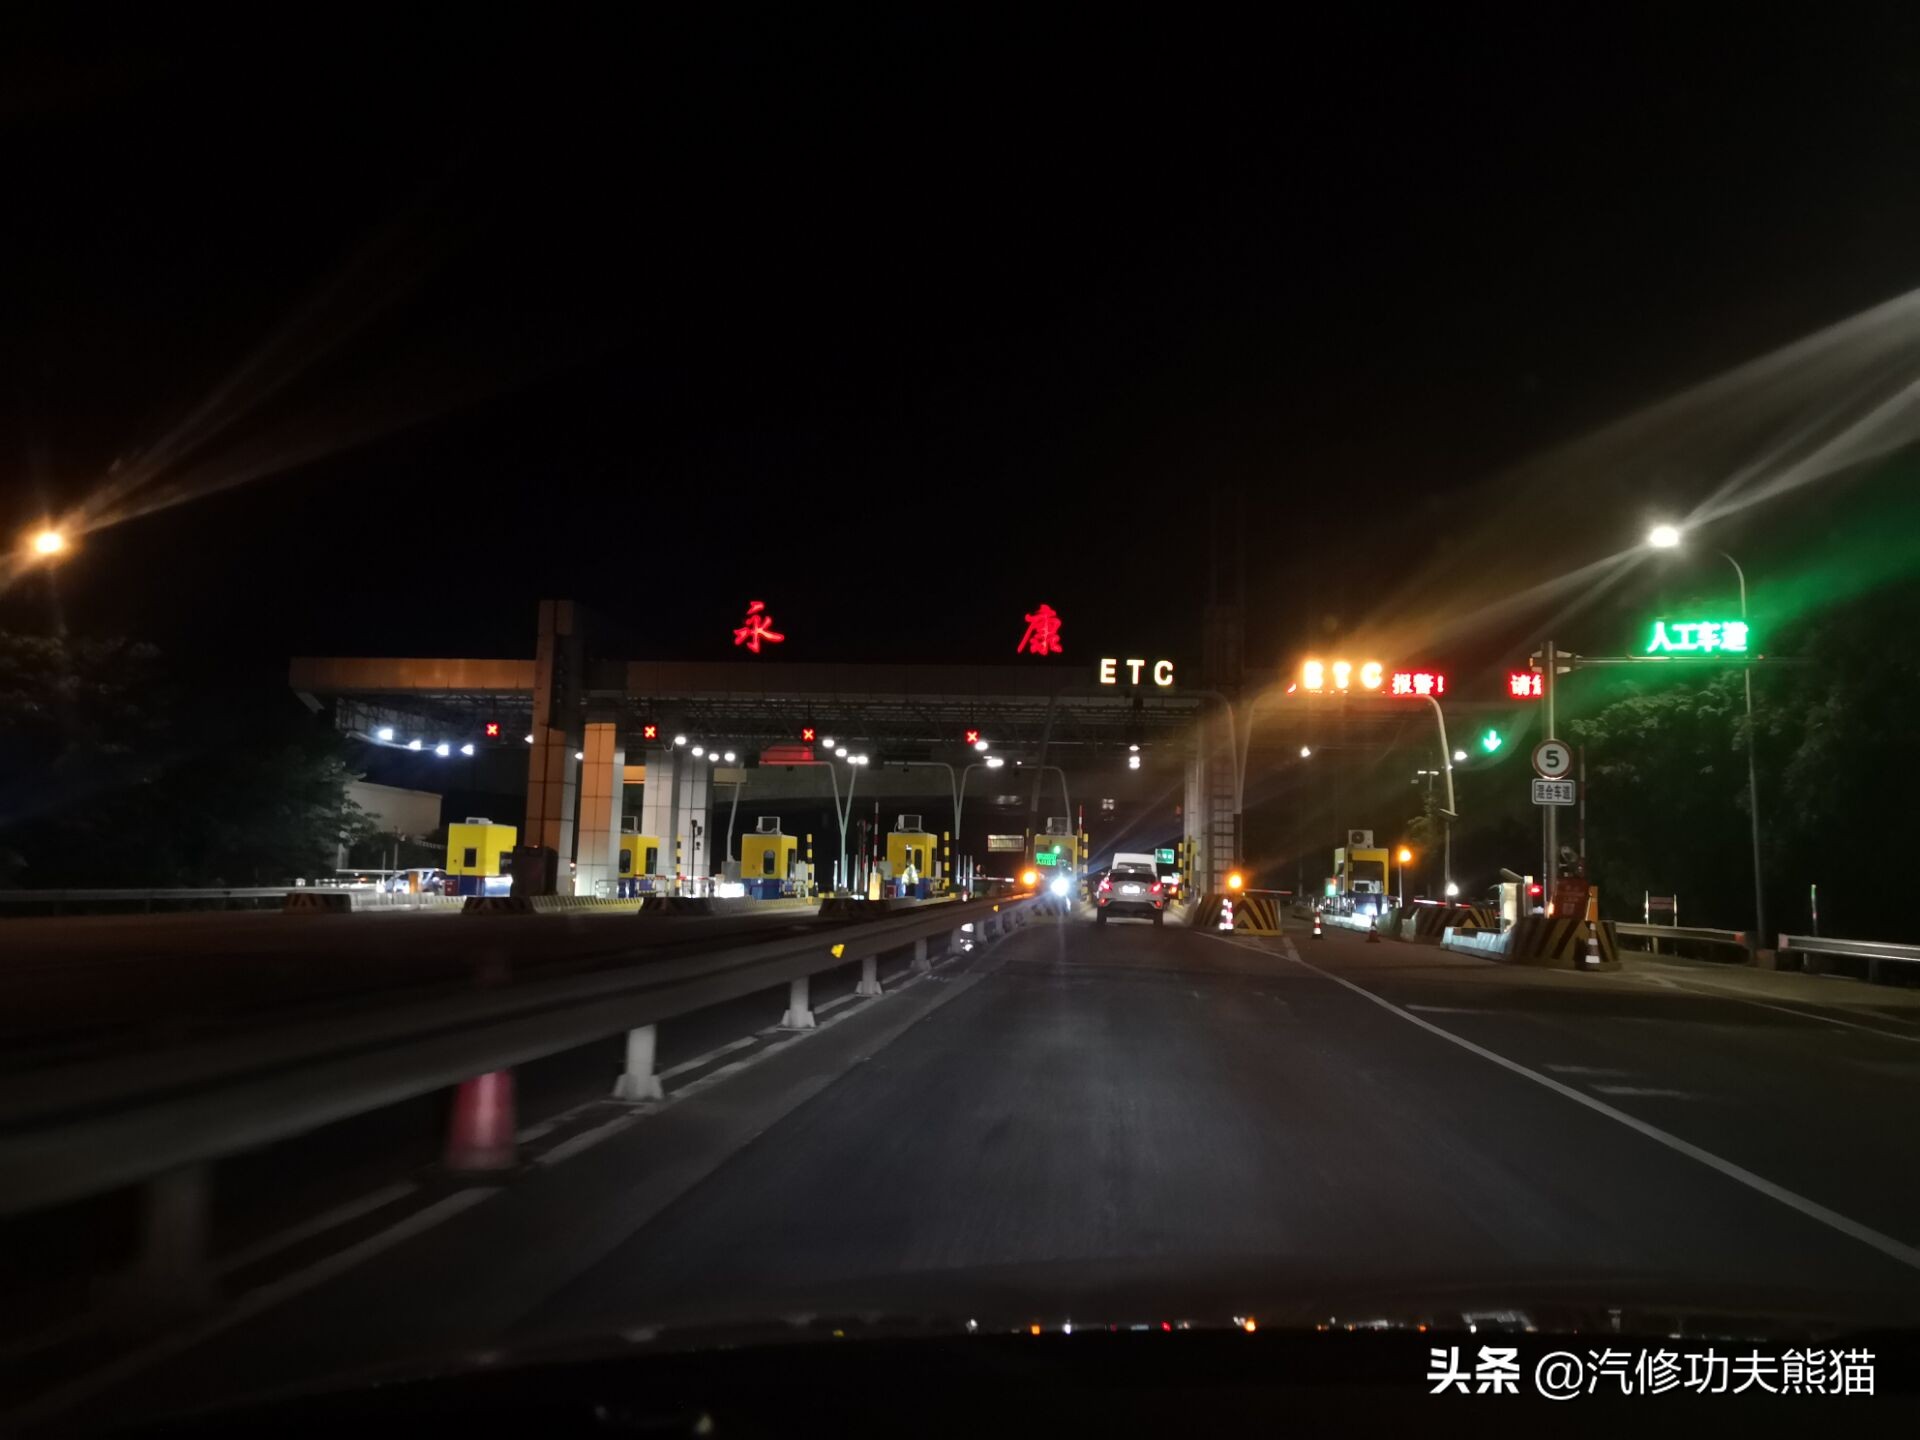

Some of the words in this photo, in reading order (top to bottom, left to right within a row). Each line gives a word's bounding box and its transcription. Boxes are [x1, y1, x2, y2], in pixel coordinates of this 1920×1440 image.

[732, 601, 784, 653] 永
[1017, 604, 1064, 656] 康
[1647, 621, 1750, 653] 人工车道
[1100, 658, 1174, 686] ETC
[1545, 750, 1560, 768] 5
[1536, 784, 1571, 800] 混合车道
